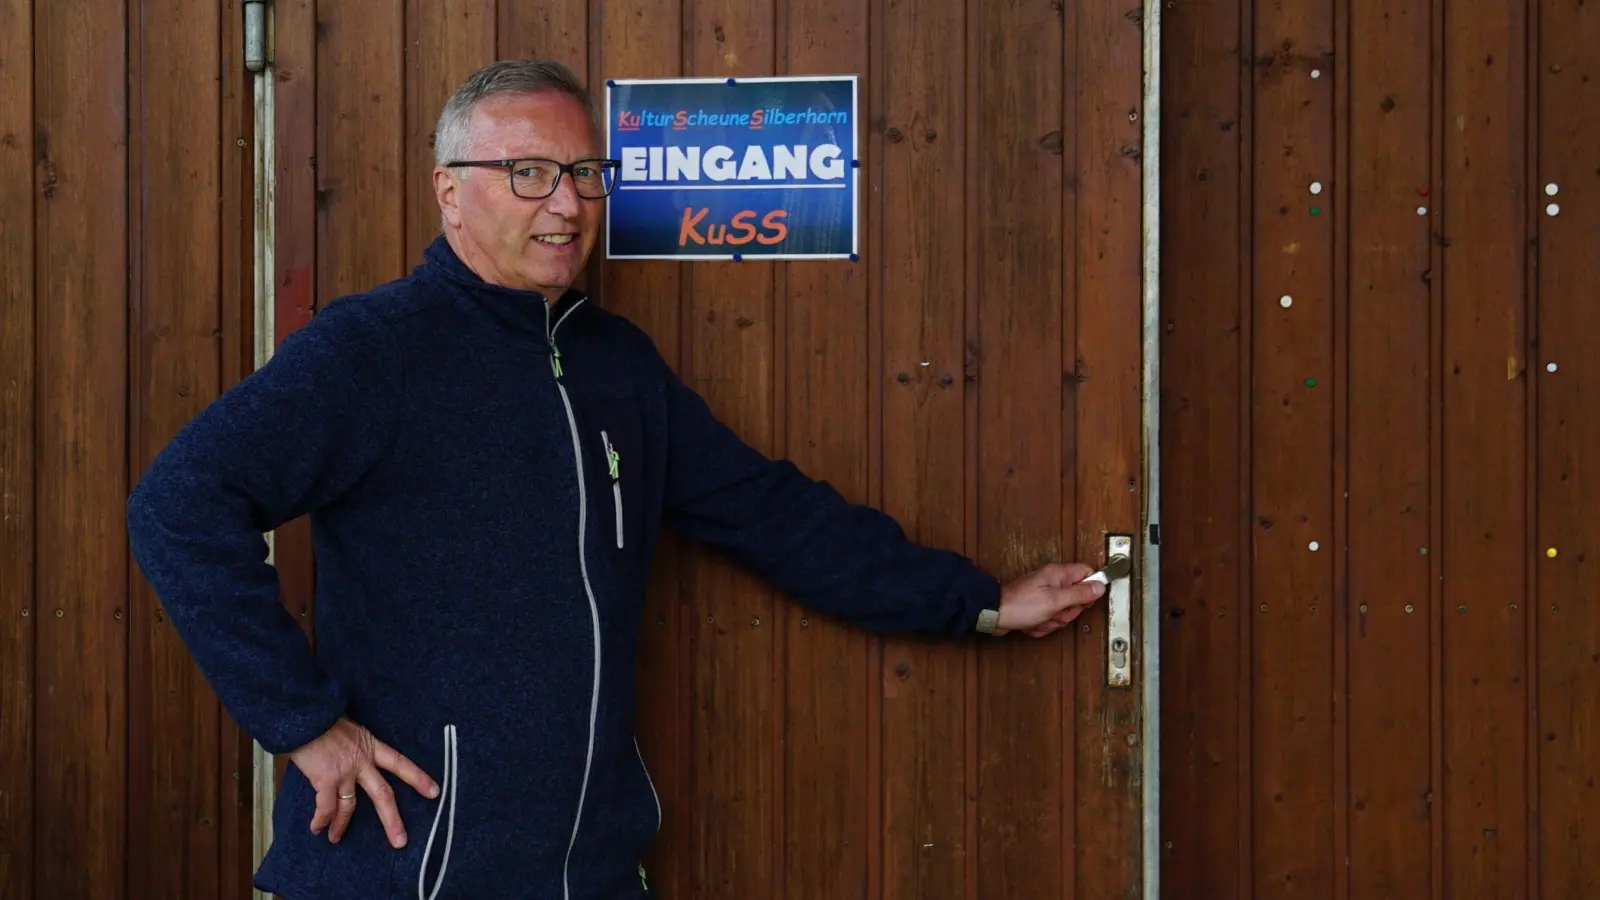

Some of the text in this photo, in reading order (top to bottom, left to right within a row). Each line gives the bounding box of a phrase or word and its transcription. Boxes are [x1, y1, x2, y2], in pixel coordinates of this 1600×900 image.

[618, 108, 848, 128] KulturScheuneSilberhorn
[621, 144, 845, 182] EINGANG
[678, 207, 788, 246] KuSS
